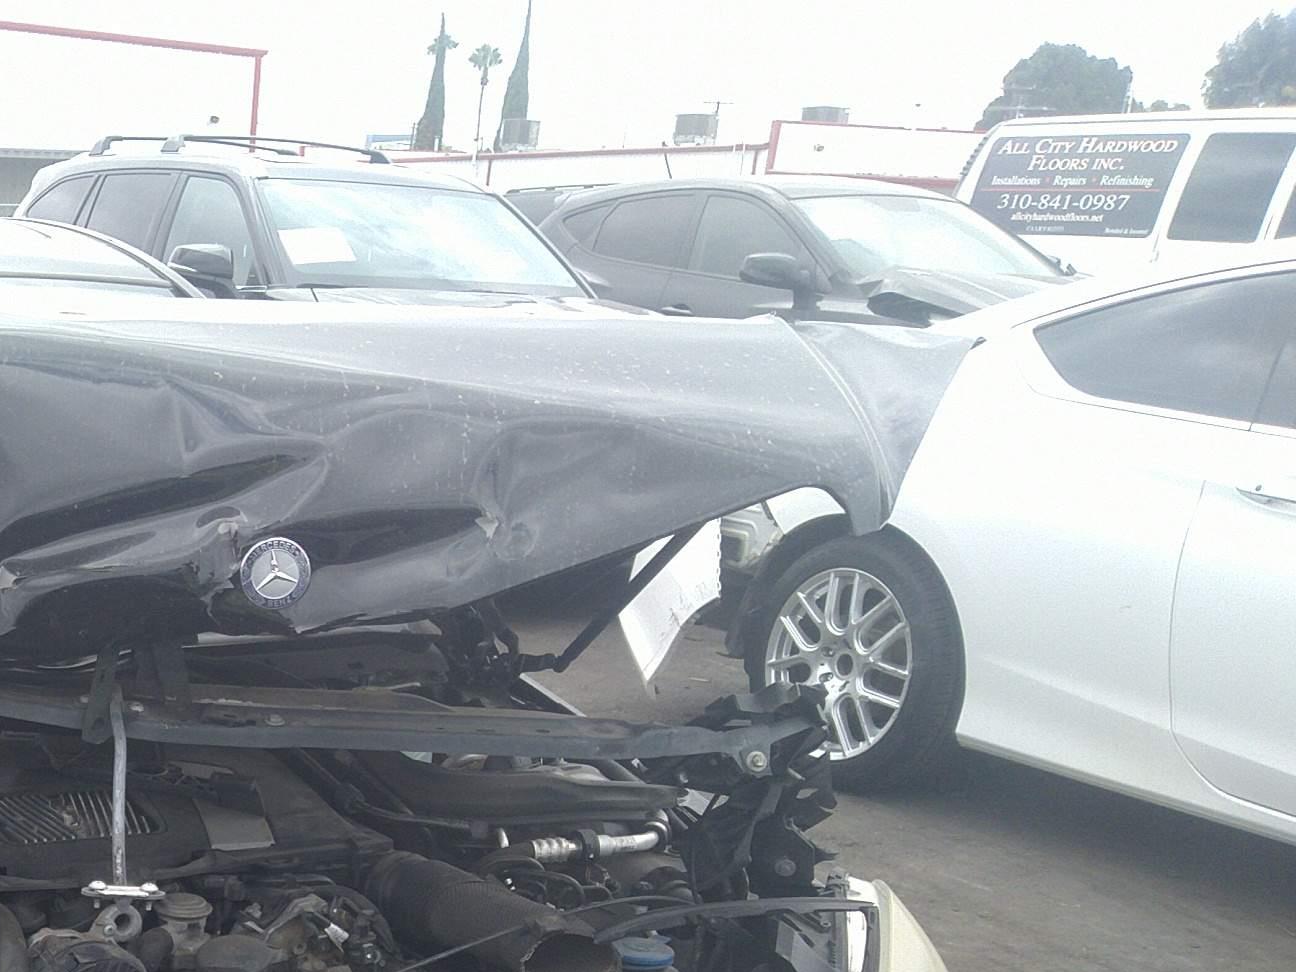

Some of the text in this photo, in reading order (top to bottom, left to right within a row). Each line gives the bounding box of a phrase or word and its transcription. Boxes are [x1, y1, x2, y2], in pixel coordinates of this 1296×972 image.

[997, 137, 1179, 155] ALL CITY HARDWOOD
[1027, 155, 1089, 171] FLOORS
[991, 174, 1154, 188] Installations Repairs Refinishing
[996, 193, 1130, 210] 310-841-0987
